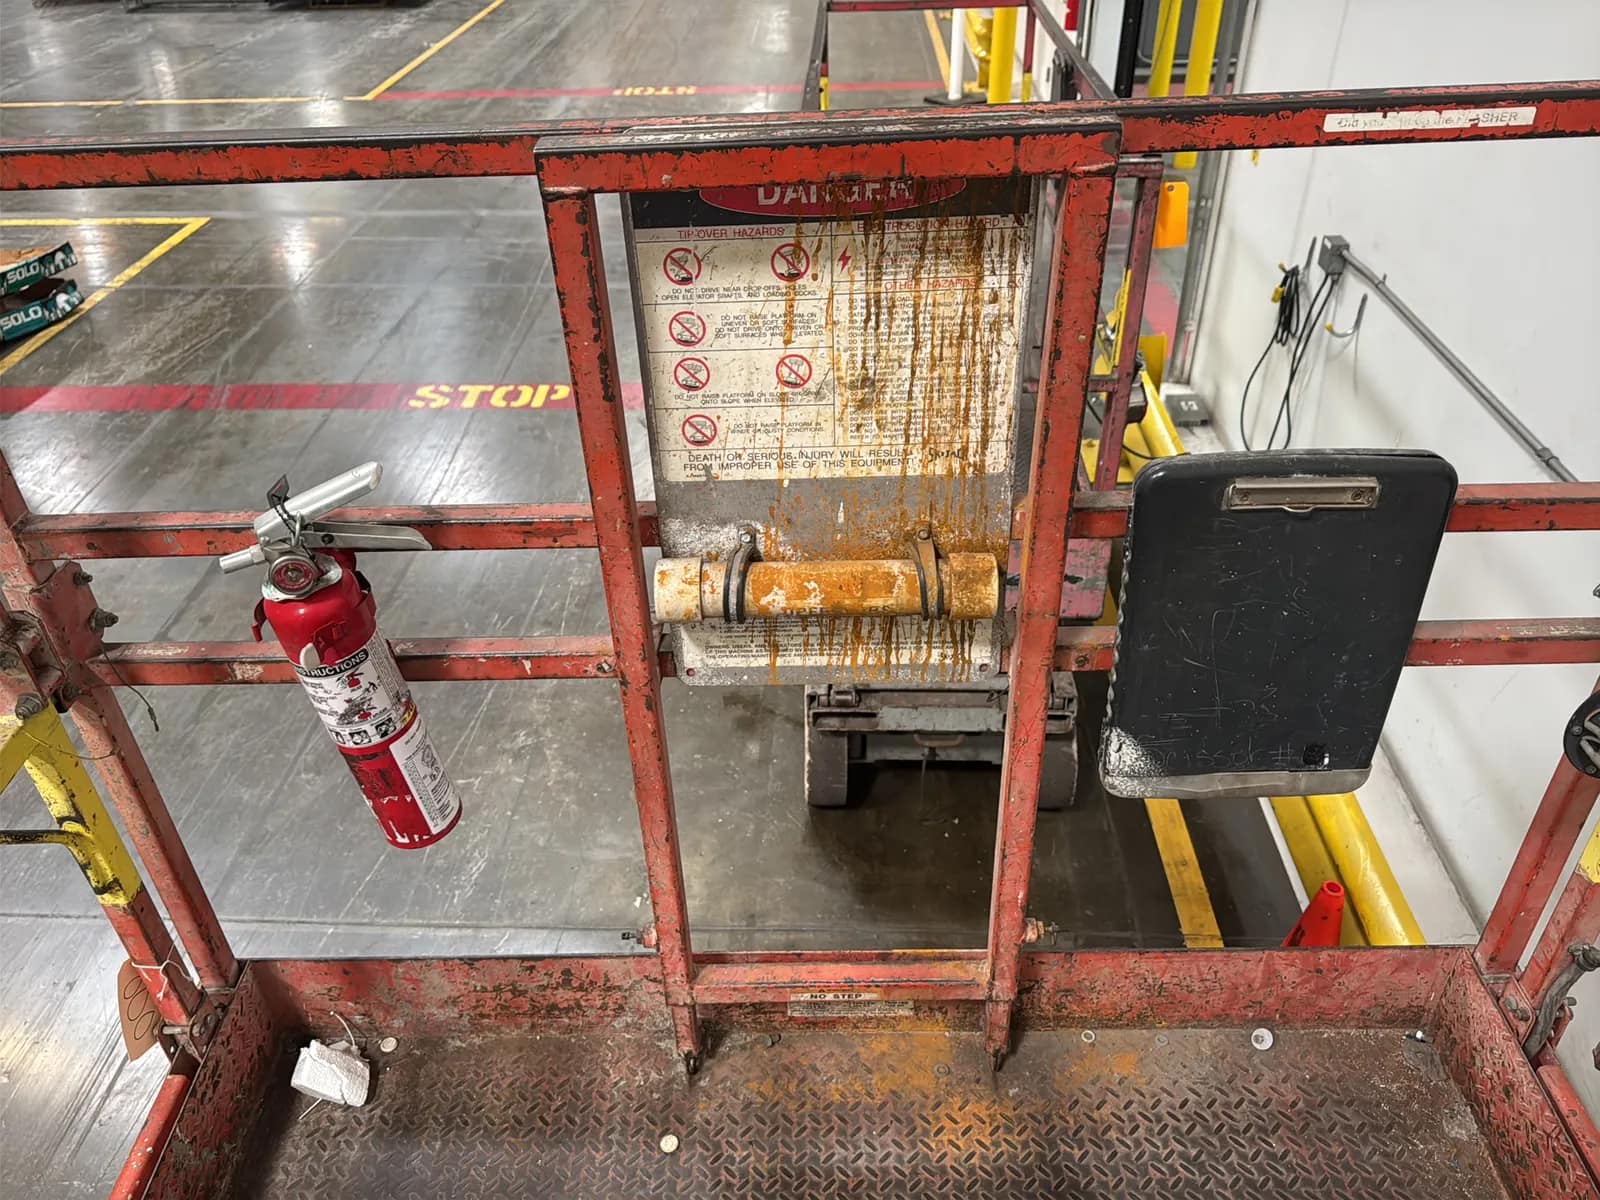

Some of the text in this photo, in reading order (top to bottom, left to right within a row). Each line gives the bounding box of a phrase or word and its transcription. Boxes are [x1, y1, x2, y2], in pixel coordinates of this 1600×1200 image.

[733, 226, 785, 238] HAZARDS
[7, 261, 40, 284] SOLO
[0, 305, 42, 331] SOLO
[408, 384, 571, 409] STOP
[688, 454, 722, 462] DEATH
[726, 453, 742, 462] OR
[798, 450, 835, 460] INJURY
[839, 450, 864, 458] WILL
[684, 464, 713, 472] FROM
[718, 462, 772, 470] IMPROPER
[803, 460, 816, 468] OF
[822, 460, 846, 468] THIS
